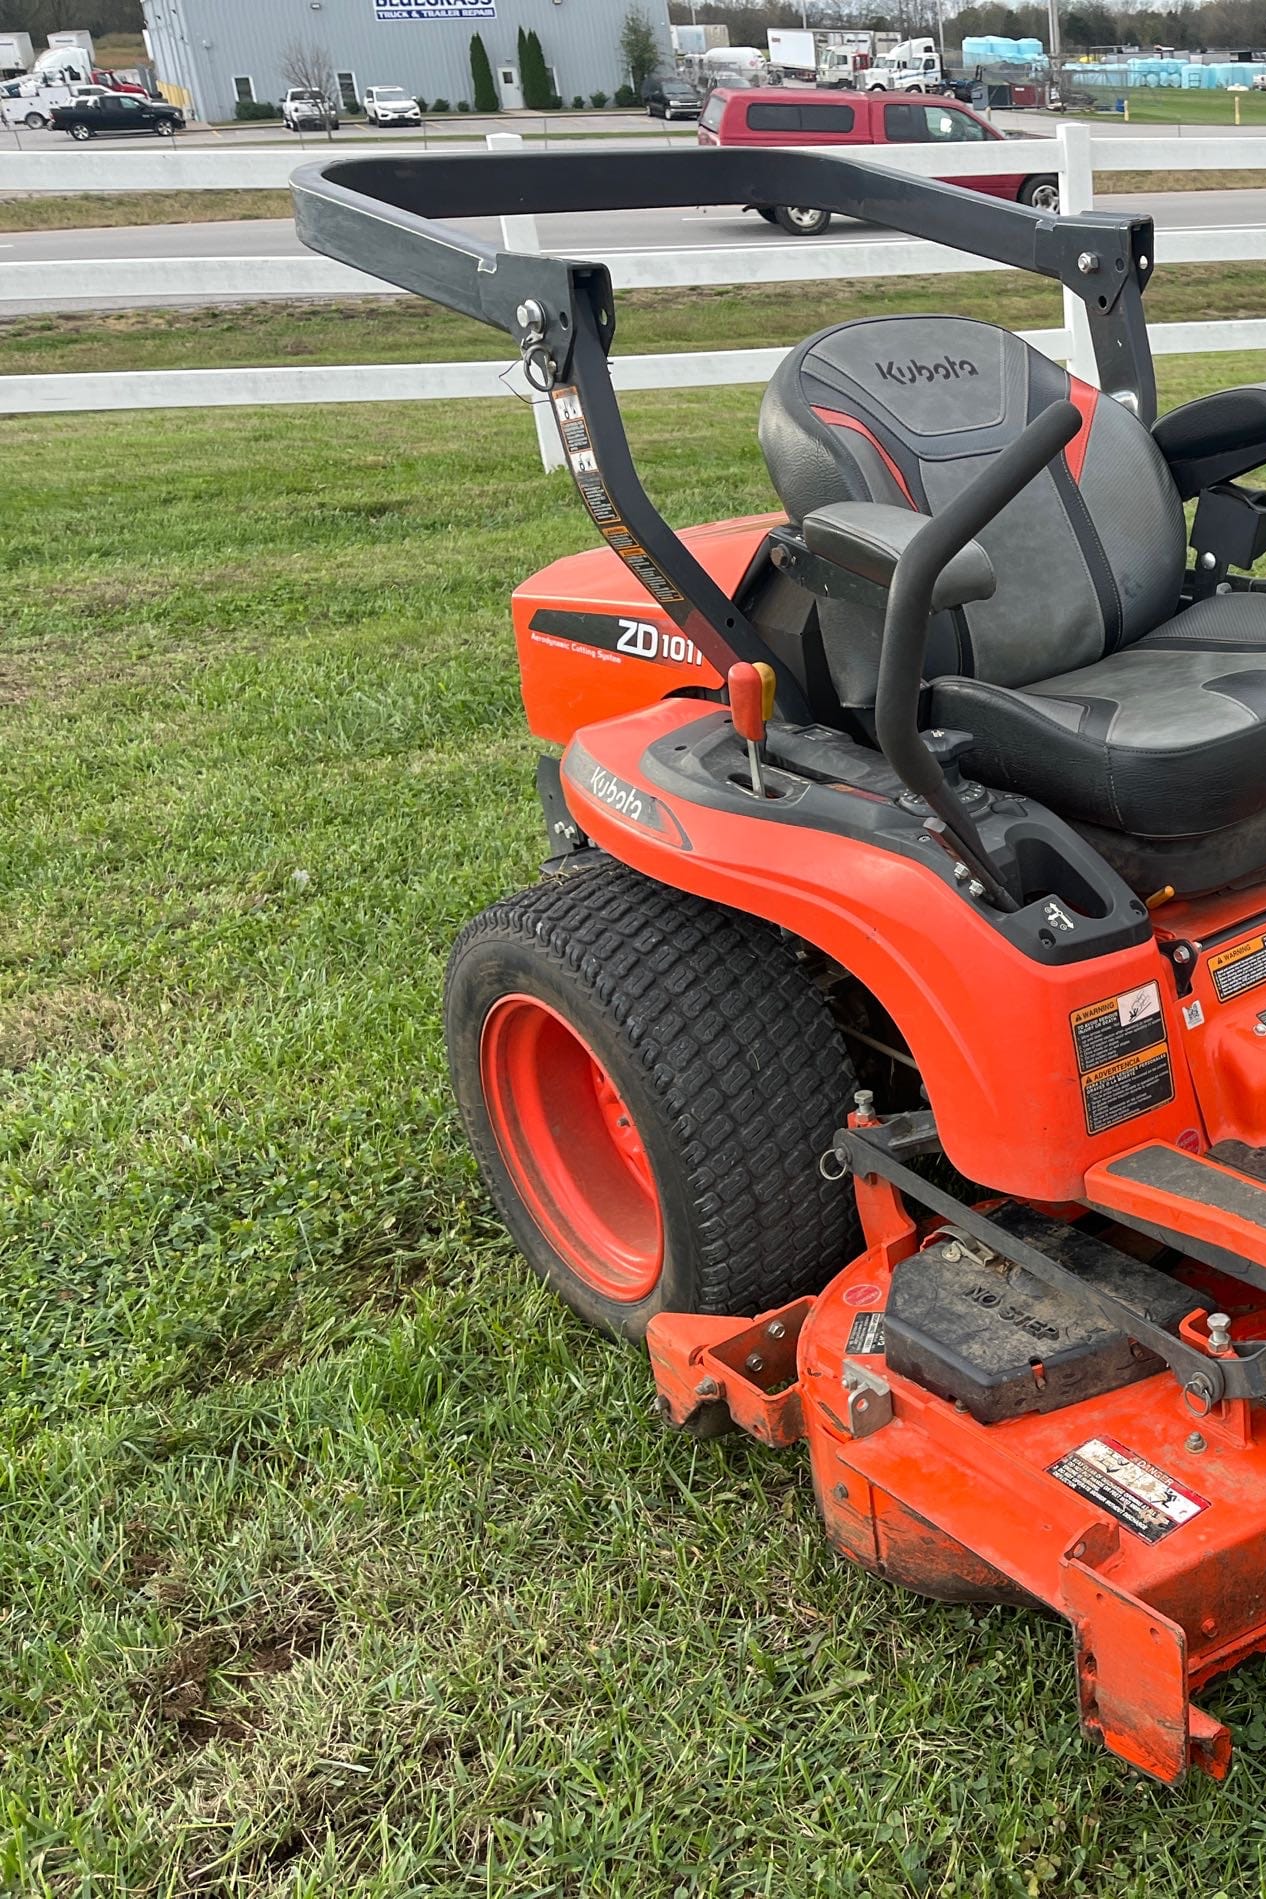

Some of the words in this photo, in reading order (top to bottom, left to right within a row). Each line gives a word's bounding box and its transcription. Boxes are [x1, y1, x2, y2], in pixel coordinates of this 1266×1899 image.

[423, 9, 459, 17] TRAILER
[462, 8, 494, 16] REPAIR
[875, 356, 979, 384] Kubota
[531, 632, 570, 651] Aerodynamic
[571, 643, 596, 659] Cutting
[597, 649, 622, 664] System
[590, 766, 642, 821] Kubota
[1223, 943, 1251, 961] WARNING
[1082, 1000, 1114, 1019] WARNING
[1093, 1056, 1140, 1080] ADVERTENCIA
[963, 1286, 1002, 1308] NO
[998, 1306, 1059, 1341] STEP
[1135, 1460, 1174, 1485] DANGER
